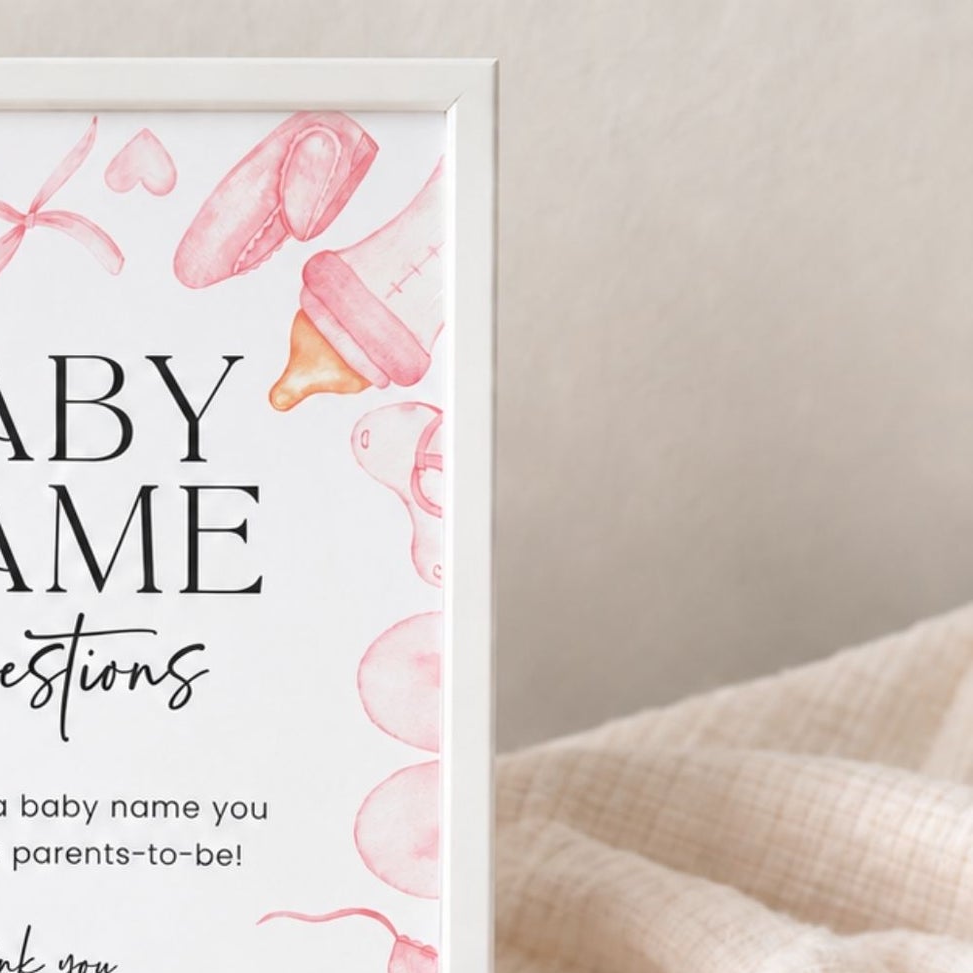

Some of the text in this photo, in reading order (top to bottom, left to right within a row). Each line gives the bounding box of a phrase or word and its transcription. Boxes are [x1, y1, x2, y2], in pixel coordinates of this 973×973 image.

[21, 793, 98, 825] baby
[111, 799, 199, 819] name
[211, 800, 267, 827] you
[12, 842, 241, 871] parents-to-be!
